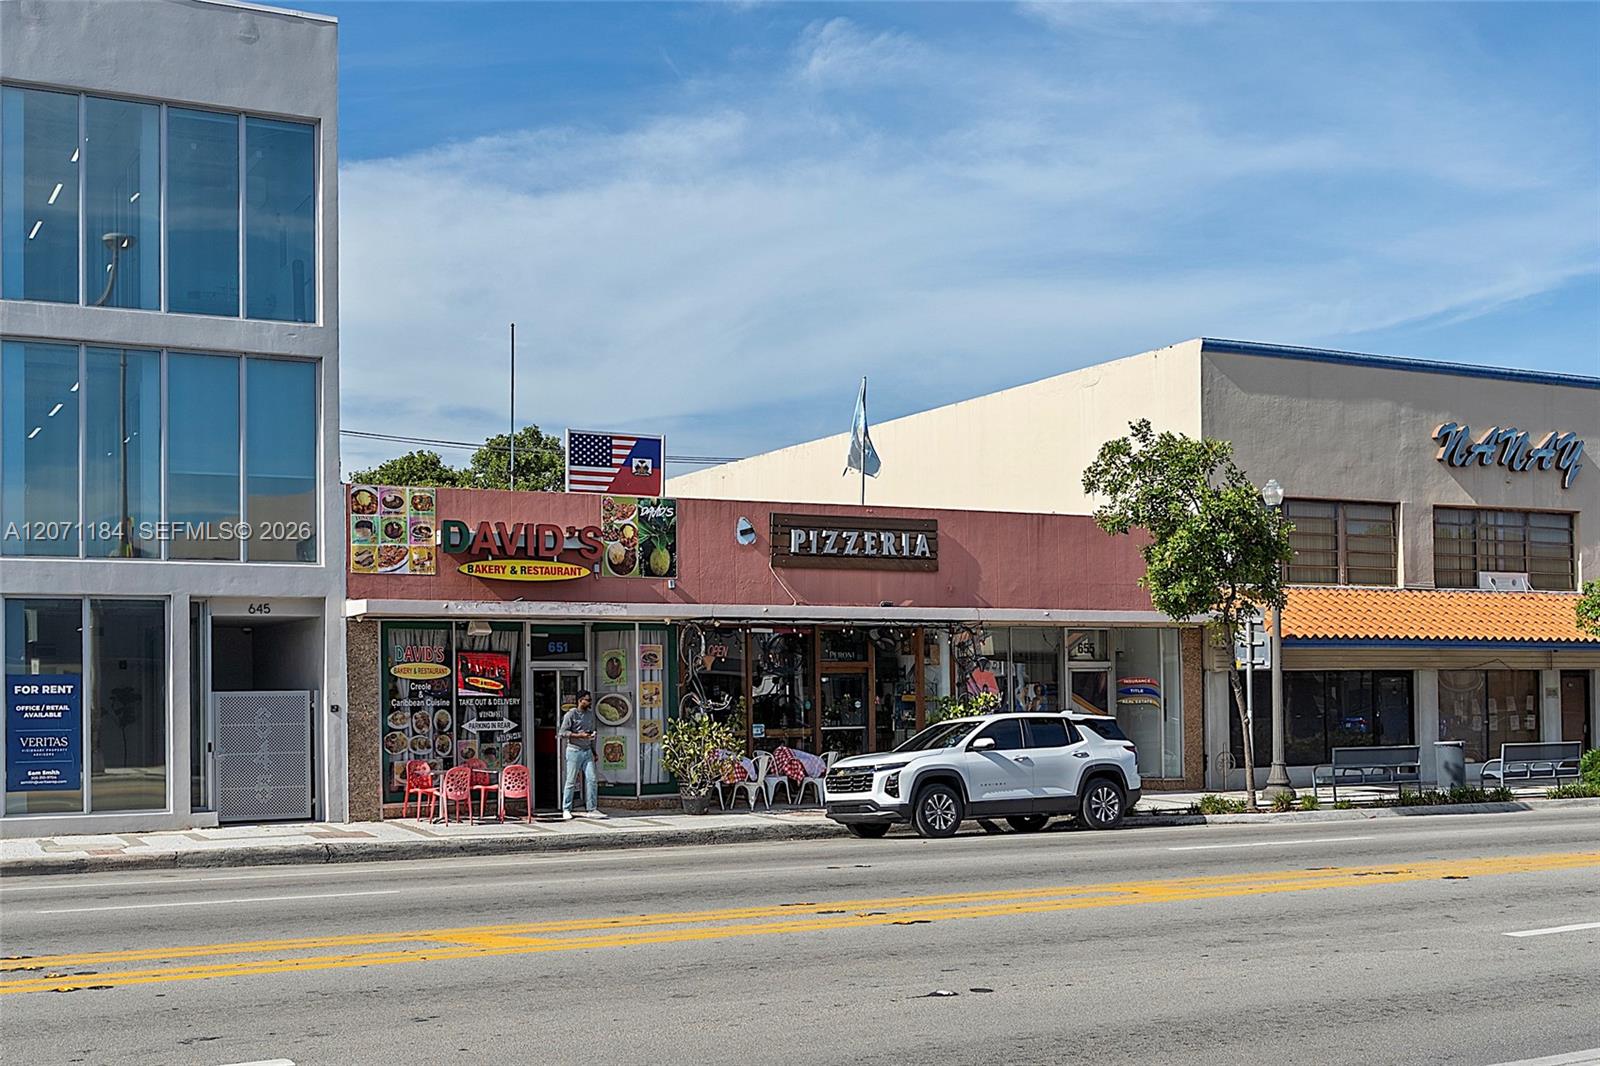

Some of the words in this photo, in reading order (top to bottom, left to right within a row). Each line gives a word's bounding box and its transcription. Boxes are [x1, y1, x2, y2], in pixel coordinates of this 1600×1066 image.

[1431, 421, 1585, 489] NANAY
[441, 519, 604, 560] DAVID'S
[790, 528, 931, 557] PIZZERIA
[467, 564, 506, 575] BAKERY
[509, 565, 518, 575] &
[520, 565, 583, 577] RESTAURANT
[247, 603, 271, 614] 645
[547, 641, 568, 653] 651
[1078, 643, 1095, 654] 655
[394, 644, 445, 663] DAVID'S
[393, 667, 412, 675] BAKERY
[14, 685, 38, 695] FOR
[41, 685, 73, 694] RENT
[410, 682, 431, 690] Creole
[425, 698, 450, 707] Cuisine
[458, 698, 475, 706] TAKE
[474, 698, 487, 706] OUT
[493, 697, 521, 706] DELIVERY
[15, 704, 40, 712] OFFICE
[20, 736, 68, 747] VERITAS
